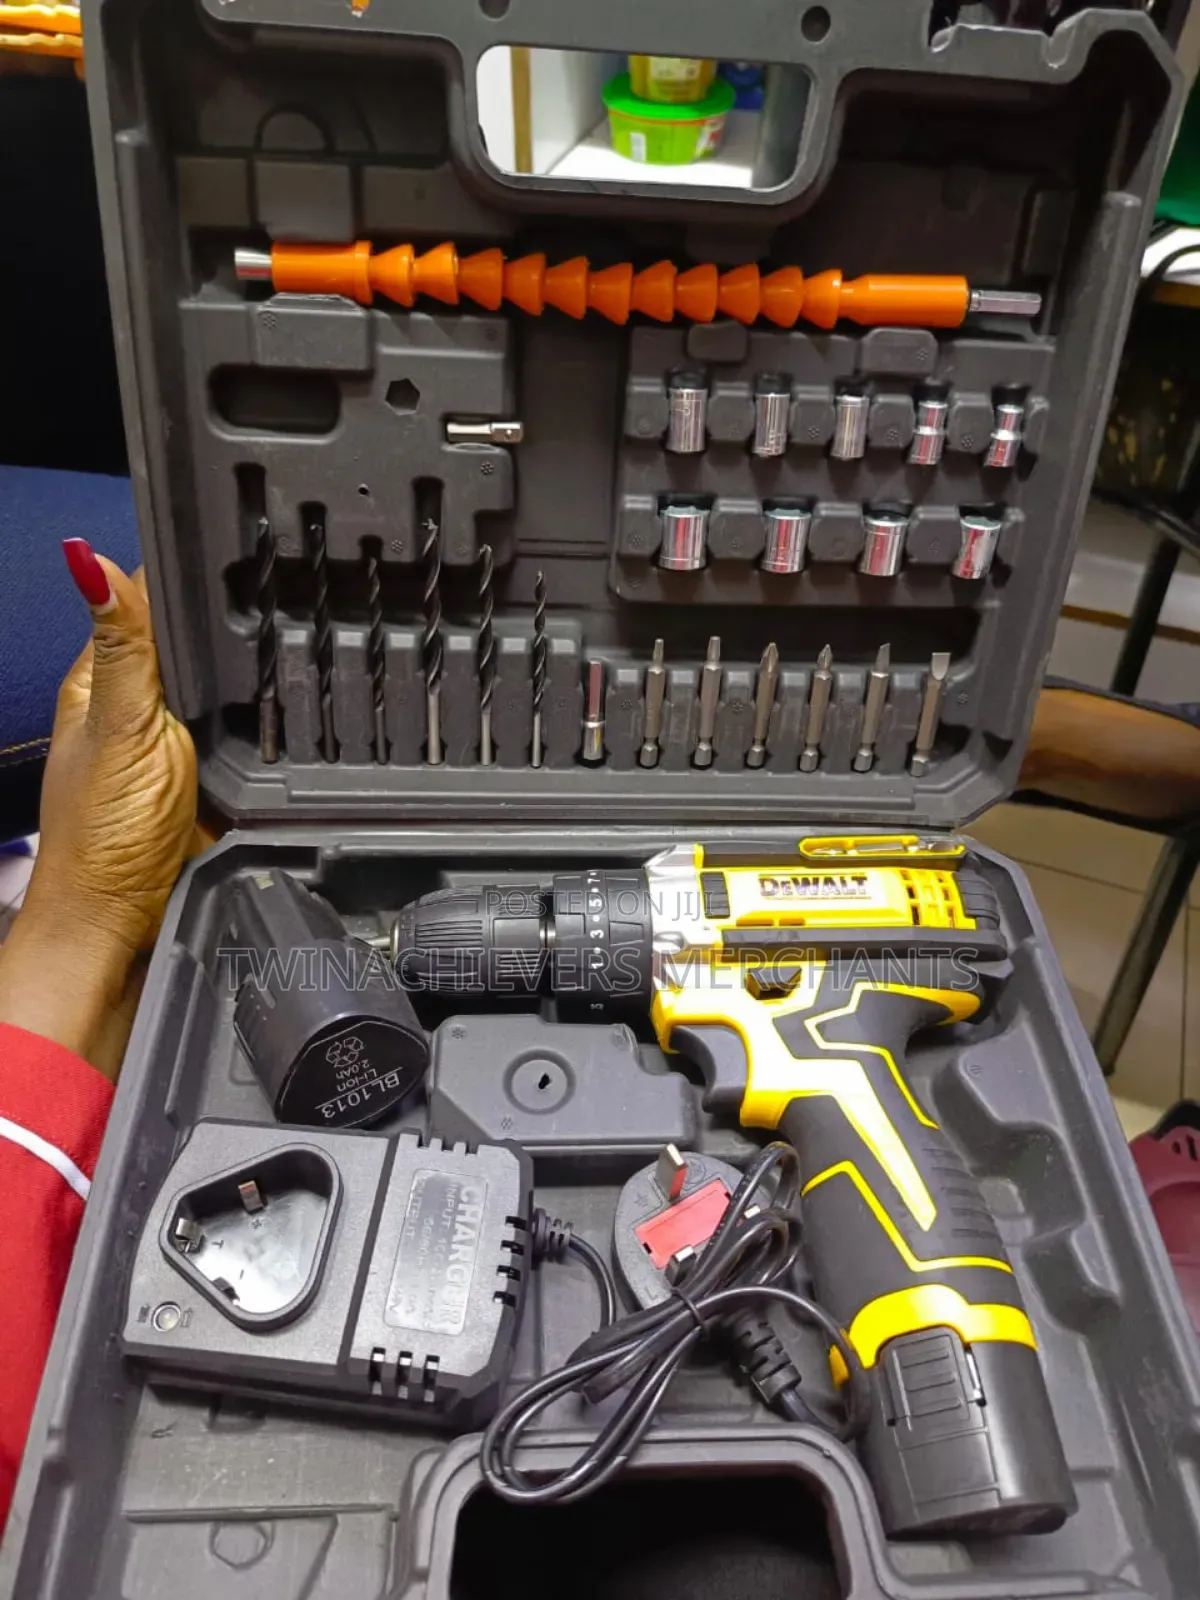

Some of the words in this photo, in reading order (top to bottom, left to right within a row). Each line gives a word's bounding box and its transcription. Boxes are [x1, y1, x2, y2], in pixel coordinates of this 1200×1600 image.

[588, 897, 603, 908] 5
[589, 929, 605, 940] 3
[591, 958, 604, 970] 1
[335, 1059, 370, 1080] 2.0Ah
[321, 1072, 400, 1119] BL1013
[437, 1185, 482, 1325] CHARGER
